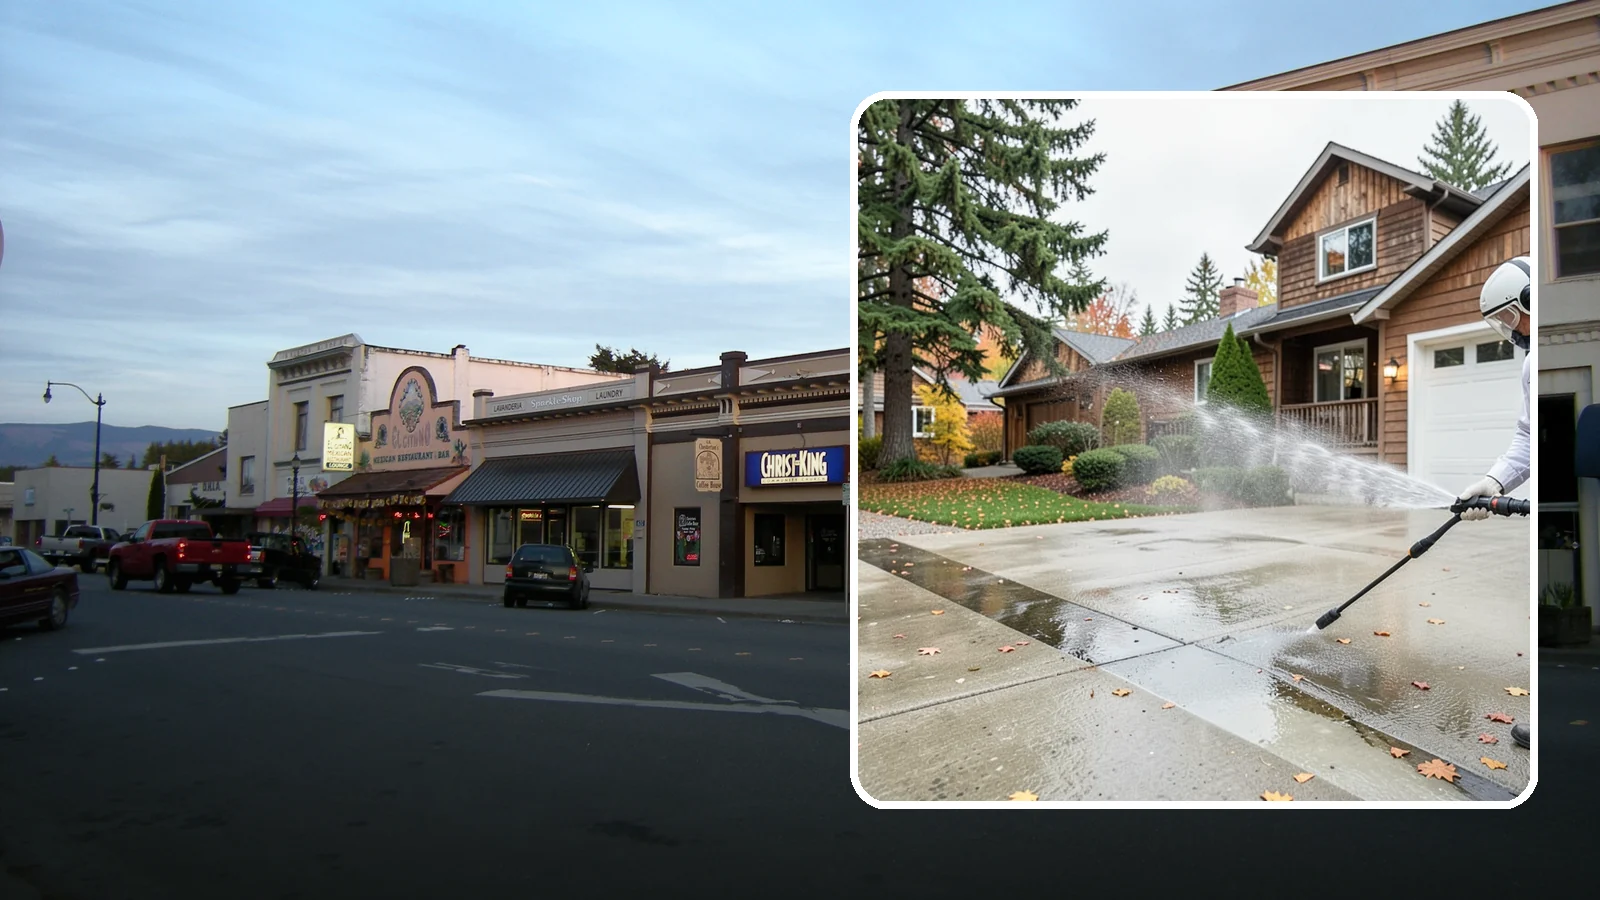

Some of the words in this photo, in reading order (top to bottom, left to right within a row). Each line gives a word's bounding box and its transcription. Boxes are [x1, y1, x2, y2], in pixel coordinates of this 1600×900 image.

[596, 389, 623, 400] LAUNDRY
[493, 402, 523, 413] LAVANDERIA
[531, 397, 561, 409] Sparkle
[562, 395, 582, 404] Shop
[373, 455, 396, 464] MEXICAN
[397, 452, 433, 462] RESTAURANT
[438, 450, 450, 459] BAR
[761, 452, 797, 478] CHRIST
[799, 450, 828, 476] KING
[696, 481, 709, 489] Coffee
[710, 481, 722, 489] House
